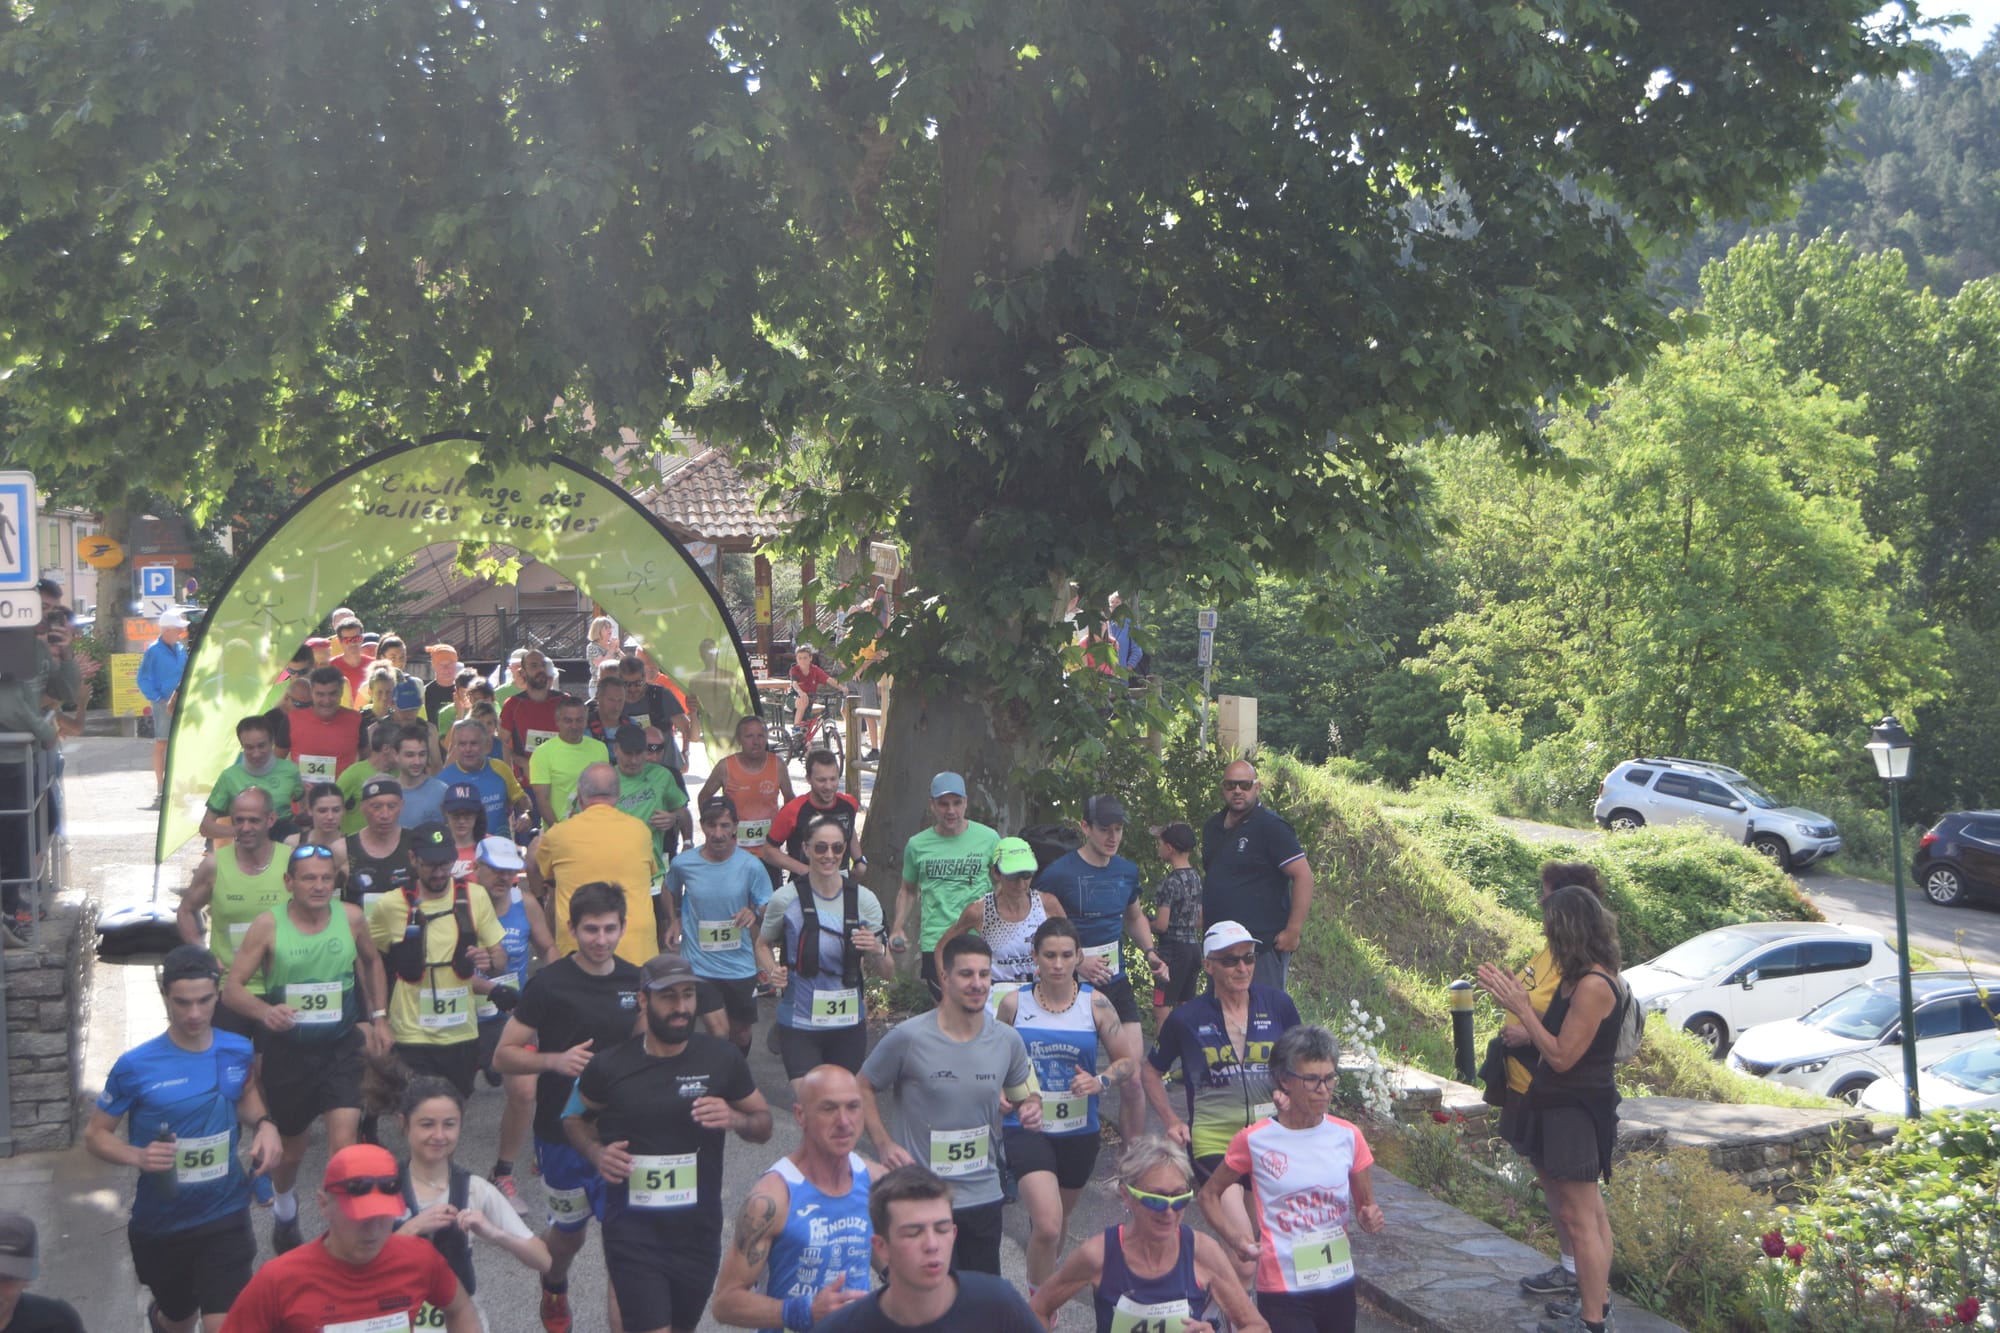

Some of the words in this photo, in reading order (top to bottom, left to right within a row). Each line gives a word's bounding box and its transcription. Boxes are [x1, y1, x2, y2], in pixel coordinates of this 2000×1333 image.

[381, 473, 522, 508] Challnge
[539, 489, 586, 508] des
[363, 499, 462, 522] vallées
[151, 573, 165, 592] P
[307, 762, 326, 775] 34
[746, 827, 763, 839] 64
[926, 863, 982, 876] FINISHER!
[709, 929, 731, 942] 15
[301, 993, 328, 1011] 39
[433, 998, 457, 1015] 81
[826, 1000, 847, 1015] 31
[1055, 1102, 1069, 1119] 8
[183, 1148, 215, 1169] 56
[947, 1141, 976, 1161] 55
[646, 1169, 676, 1190] 51
[1320, 1243, 1333, 1264] 1
[1130, 1319, 1166, 1333] 41
